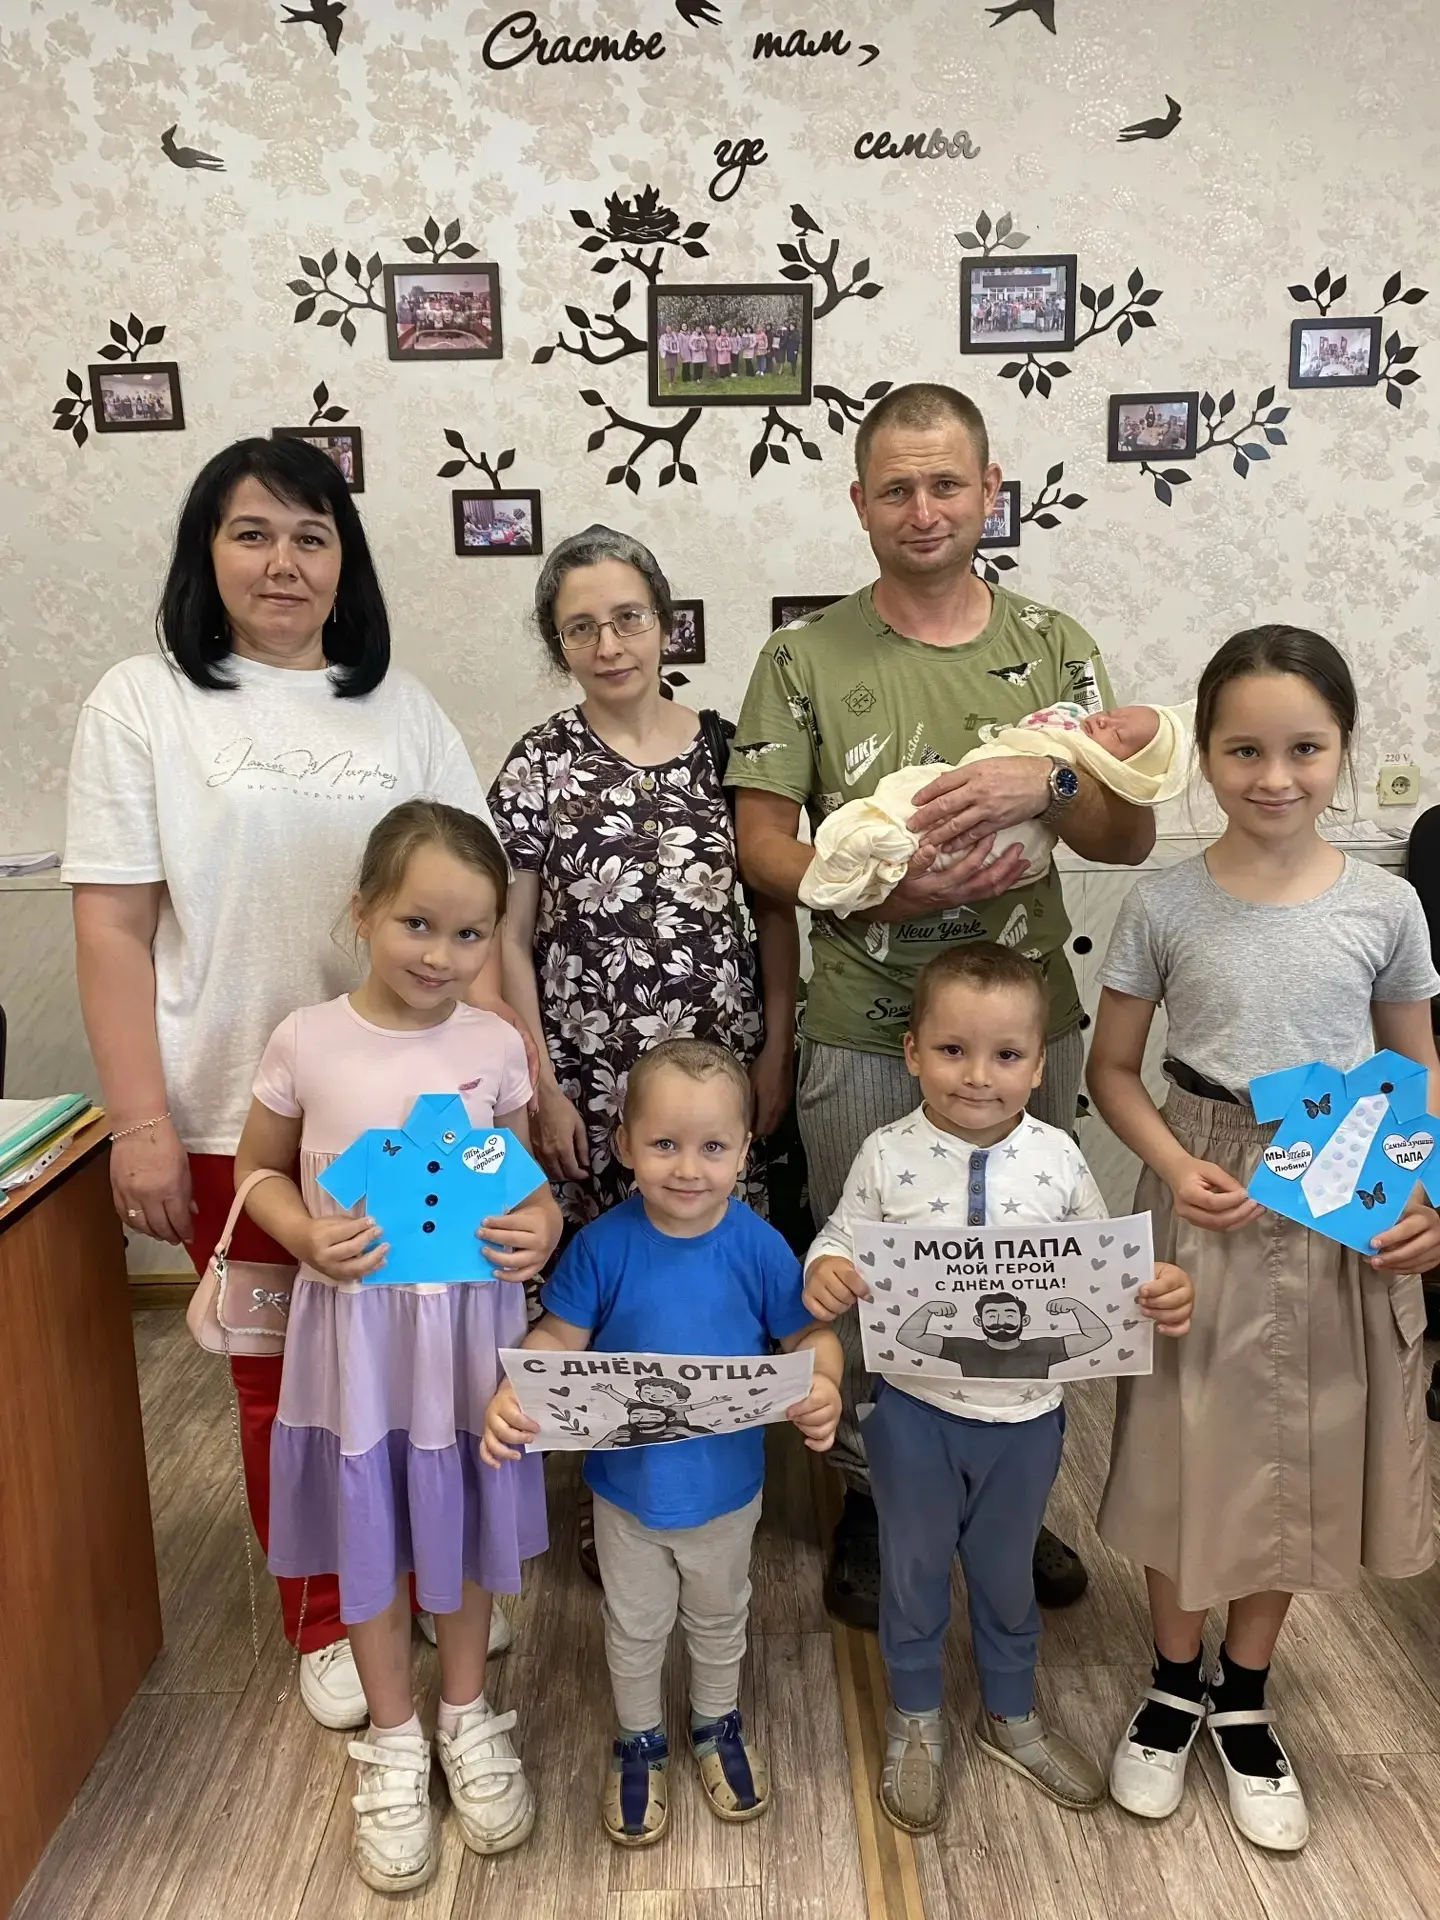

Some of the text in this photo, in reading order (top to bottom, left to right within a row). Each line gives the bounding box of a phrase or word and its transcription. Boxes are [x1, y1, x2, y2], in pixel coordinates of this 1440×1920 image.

[482, 11, 666, 70] Счастье
[708, 128, 981, 201] где семья
[845, 733, 878, 771] NIKE
[1385, 754, 1400, 763] 220
[895, 919, 987, 941] New York
[1384, 1137, 1434, 1151] Самый лучший
[463, 1148, 480, 1161] Ты
[473, 1150, 505, 1172] гордость
[476, 1146, 496, 1160] наша
[1265, 1151, 1286, 1161] МЫ
[1396, 1150, 1424, 1164] ПАПА
[1275, 1161, 1308, 1172] Любим!
[913, 1236, 1083, 1260] МОЙ ПАПА
[946, 1259, 1055, 1275] МОЙ ГЕРОЙ
[935, 1276, 1067, 1293] С ДНЁМ ОТЦА!
[522, 1357, 778, 1382] С ДНЁМ ОТЦА
